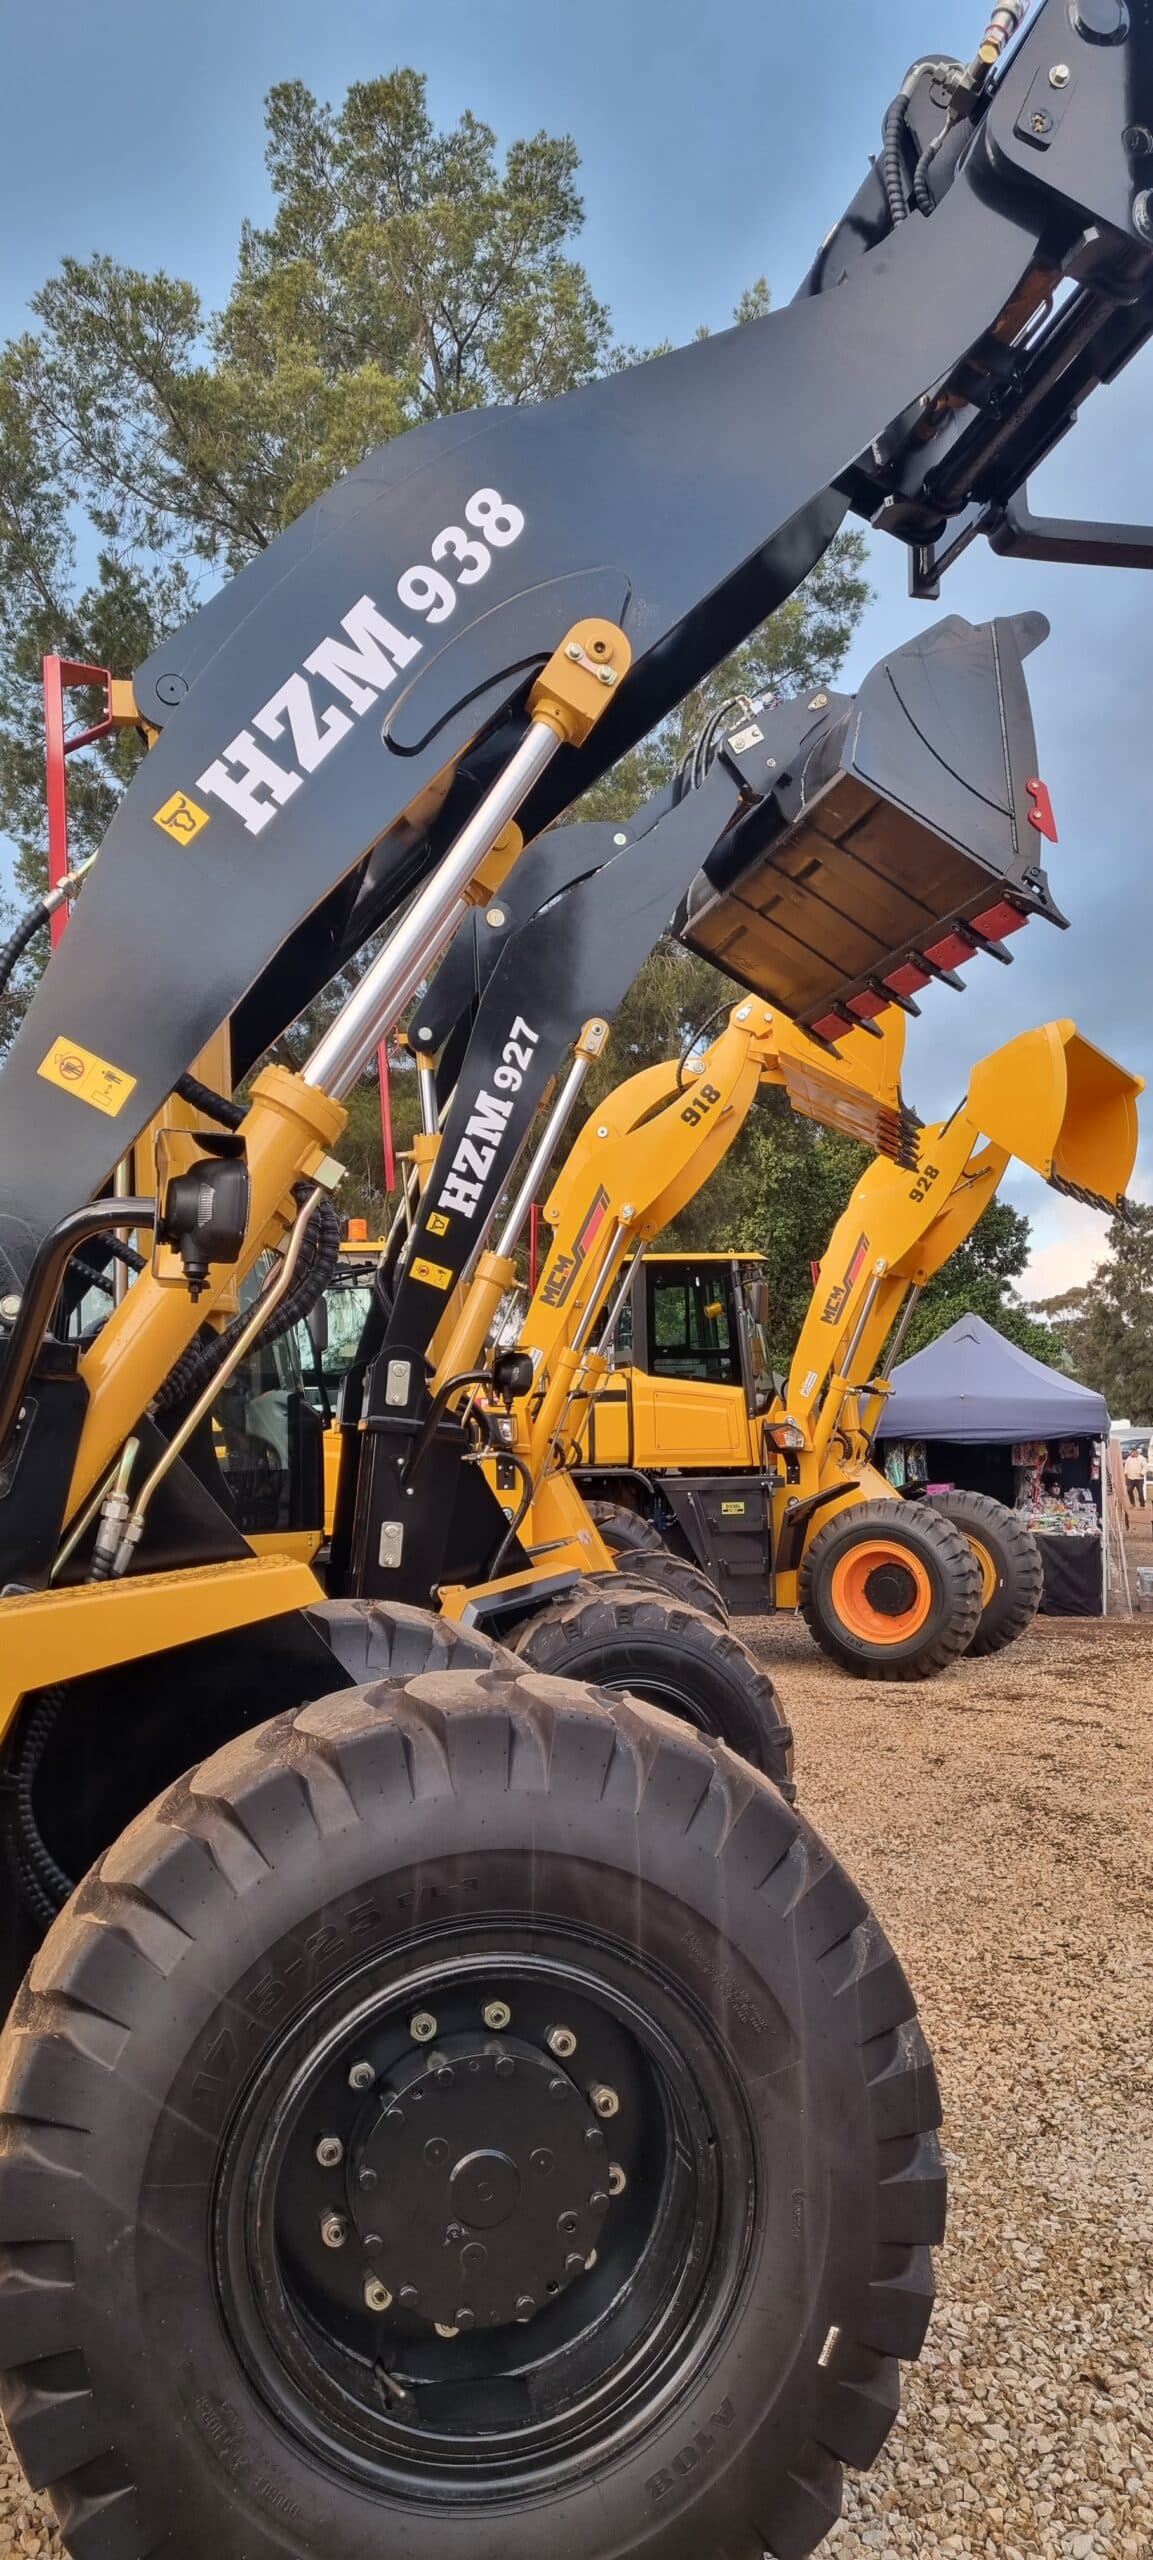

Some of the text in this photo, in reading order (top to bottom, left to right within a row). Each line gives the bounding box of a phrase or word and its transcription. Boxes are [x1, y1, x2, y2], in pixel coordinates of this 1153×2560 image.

[195, 488, 525, 836] HZM 938
[438, 1016, 540, 1219] HZM 927
[680, 1083, 721, 1127] 918
[908, 1164, 940, 1203] 928
[539, 1254, 574, 1307] MCM
[820, 1285, 845, 1325] MCM
